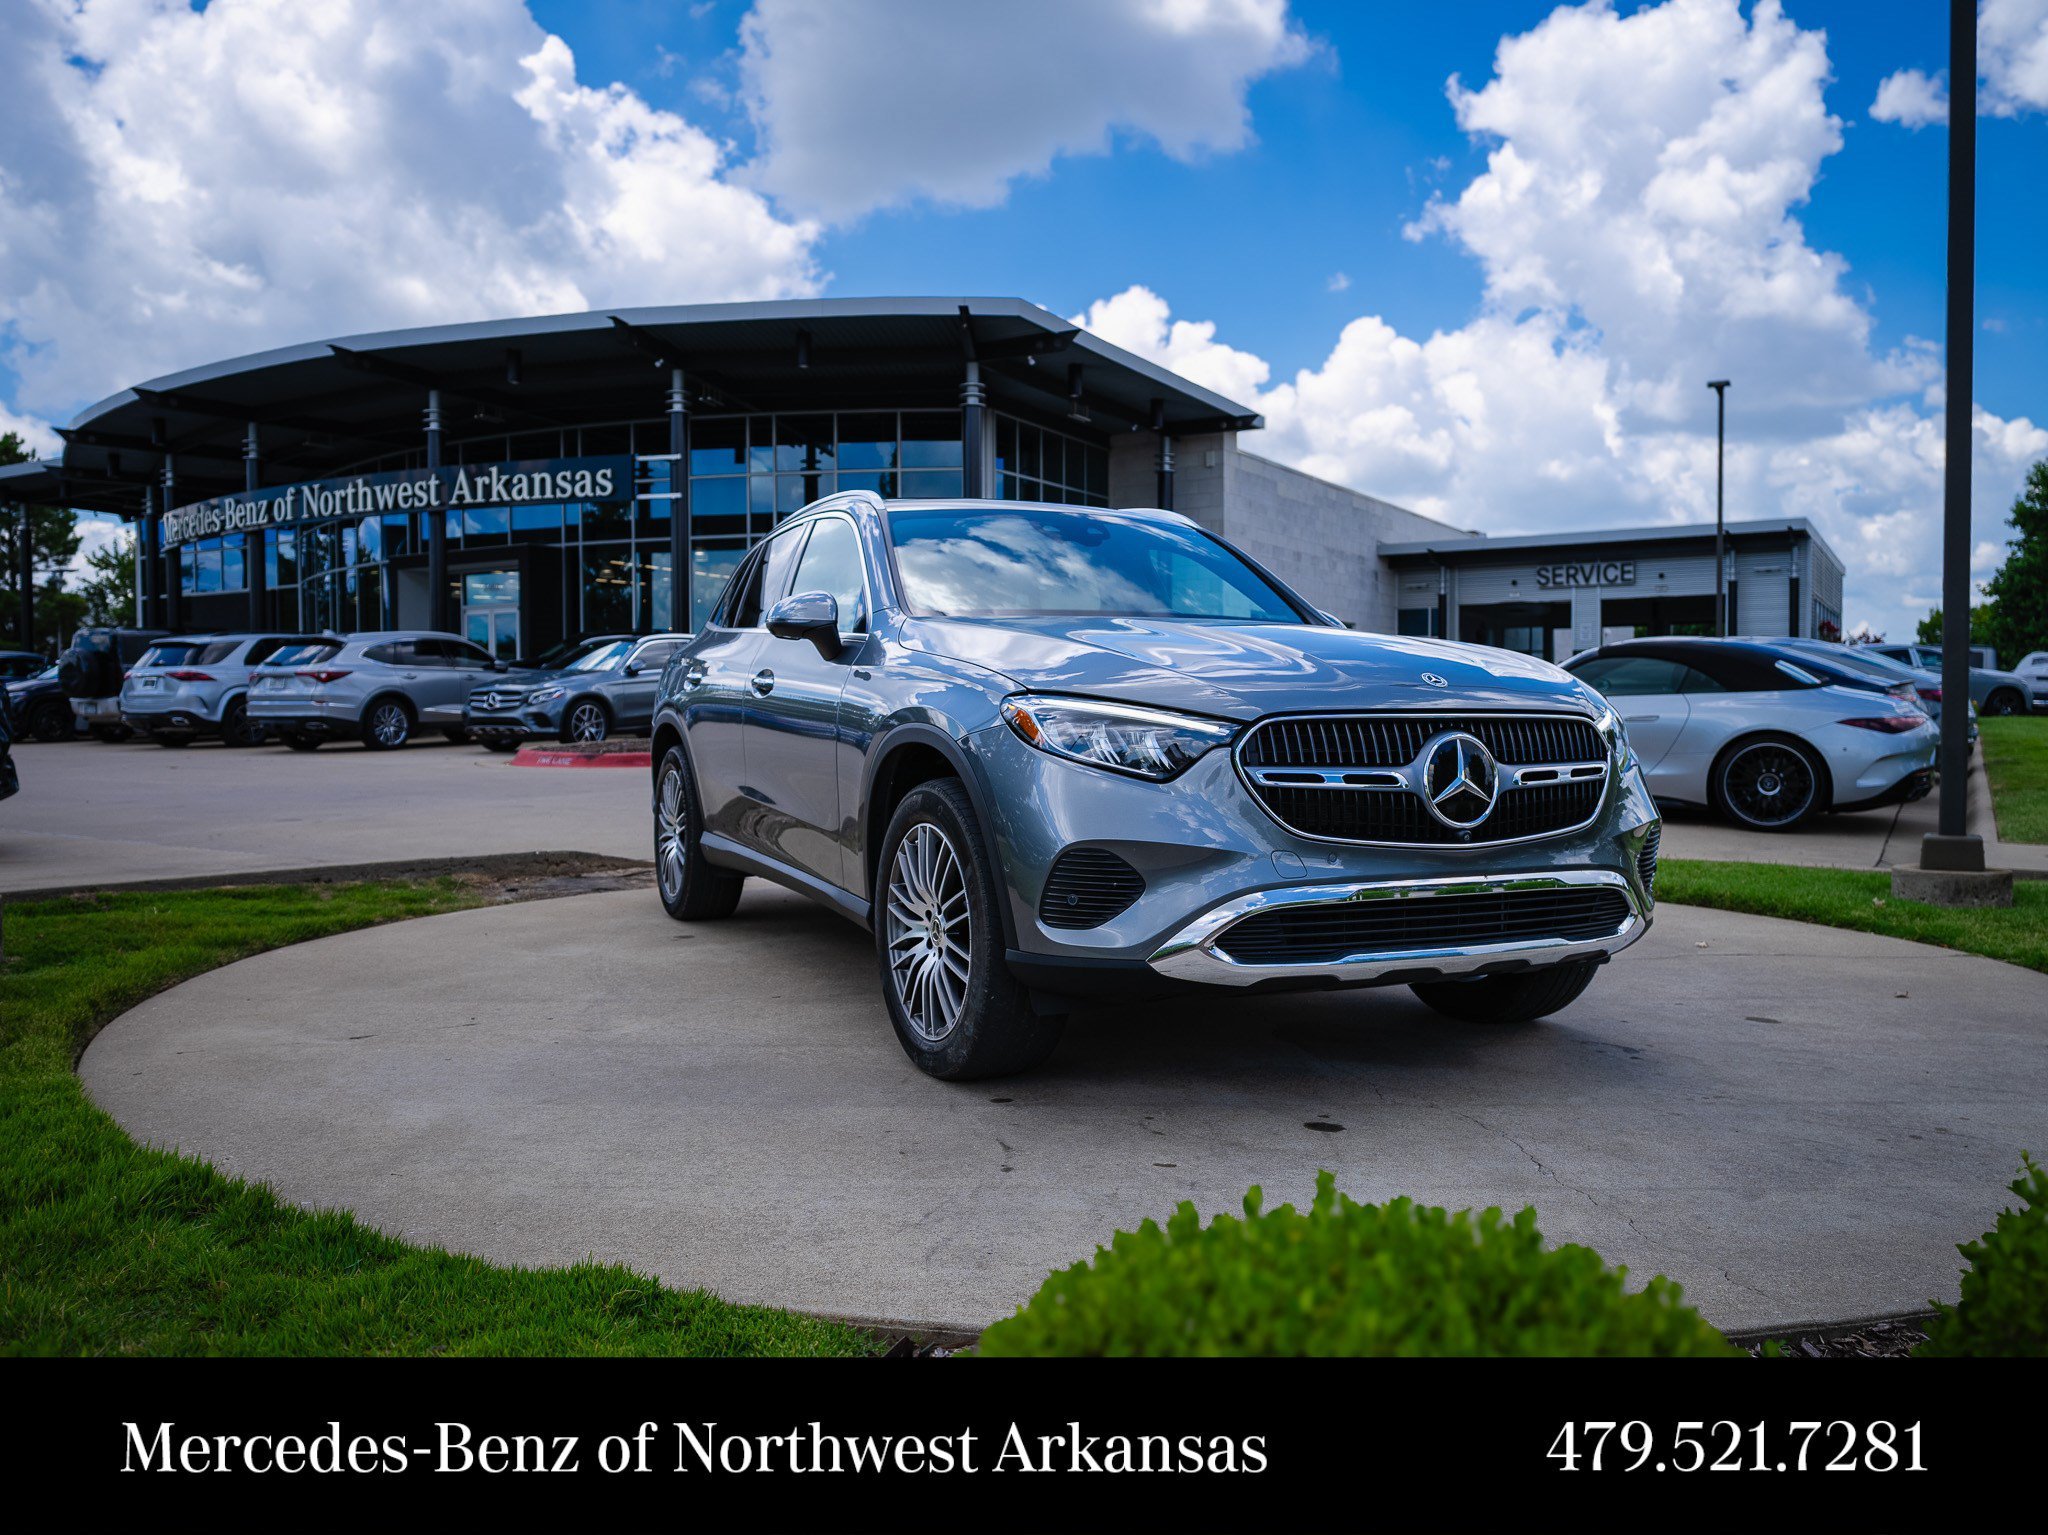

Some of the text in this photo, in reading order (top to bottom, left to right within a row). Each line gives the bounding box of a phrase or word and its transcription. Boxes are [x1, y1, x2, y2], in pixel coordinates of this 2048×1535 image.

[163, 465, 614, 544] Mercedes-Benz of Northwest Arkansas
[1536, 562, 1633, 587] SERVICE
